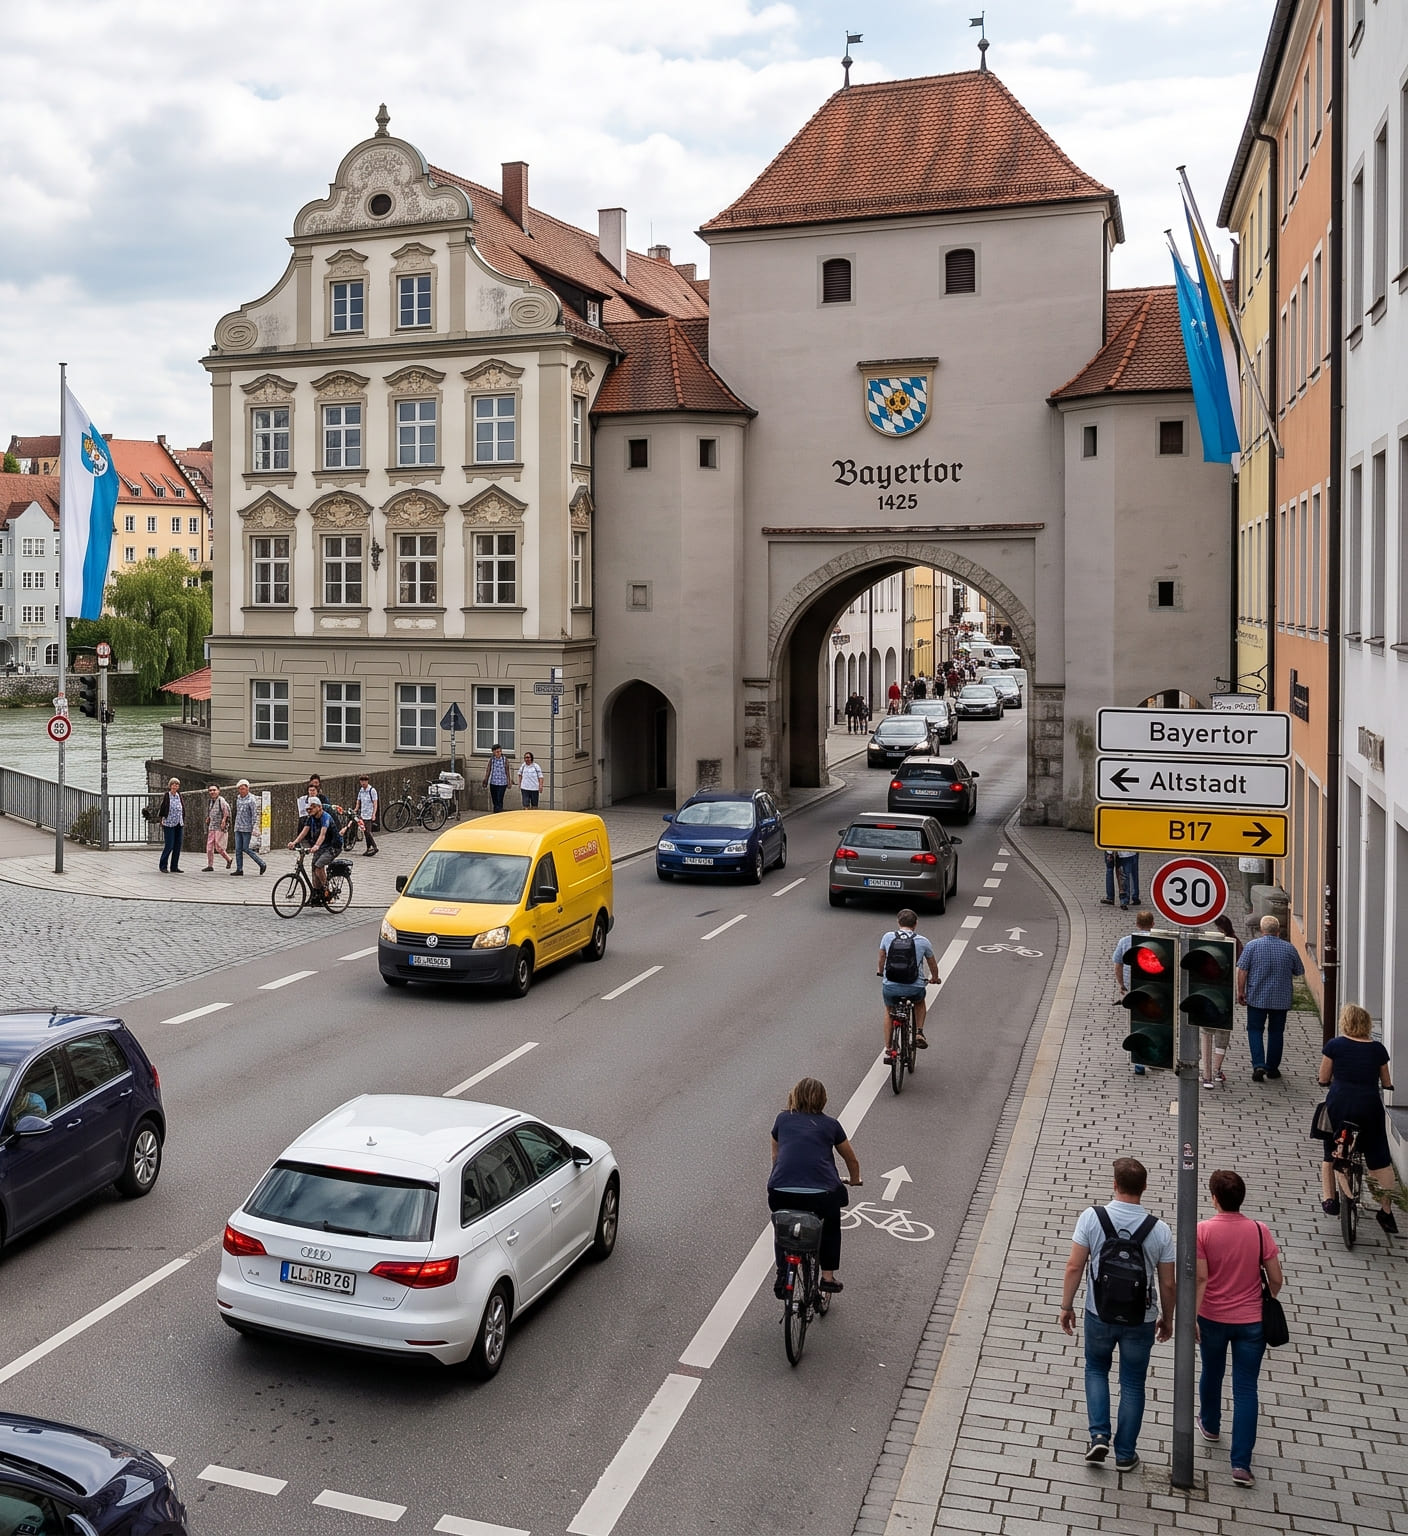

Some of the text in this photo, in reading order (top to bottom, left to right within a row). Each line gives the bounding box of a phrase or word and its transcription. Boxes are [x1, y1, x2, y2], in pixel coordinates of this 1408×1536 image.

[831, 457, 964, 490] Bayertor
[877, 493, 918, 511] 1425
[1150, 721, 1258, 748] Bayertor
[1149, 771, 1247, 794] Altstadt
[1169, 820, 1212, 842] B17
[1168, 876, 1210, 908] 30
